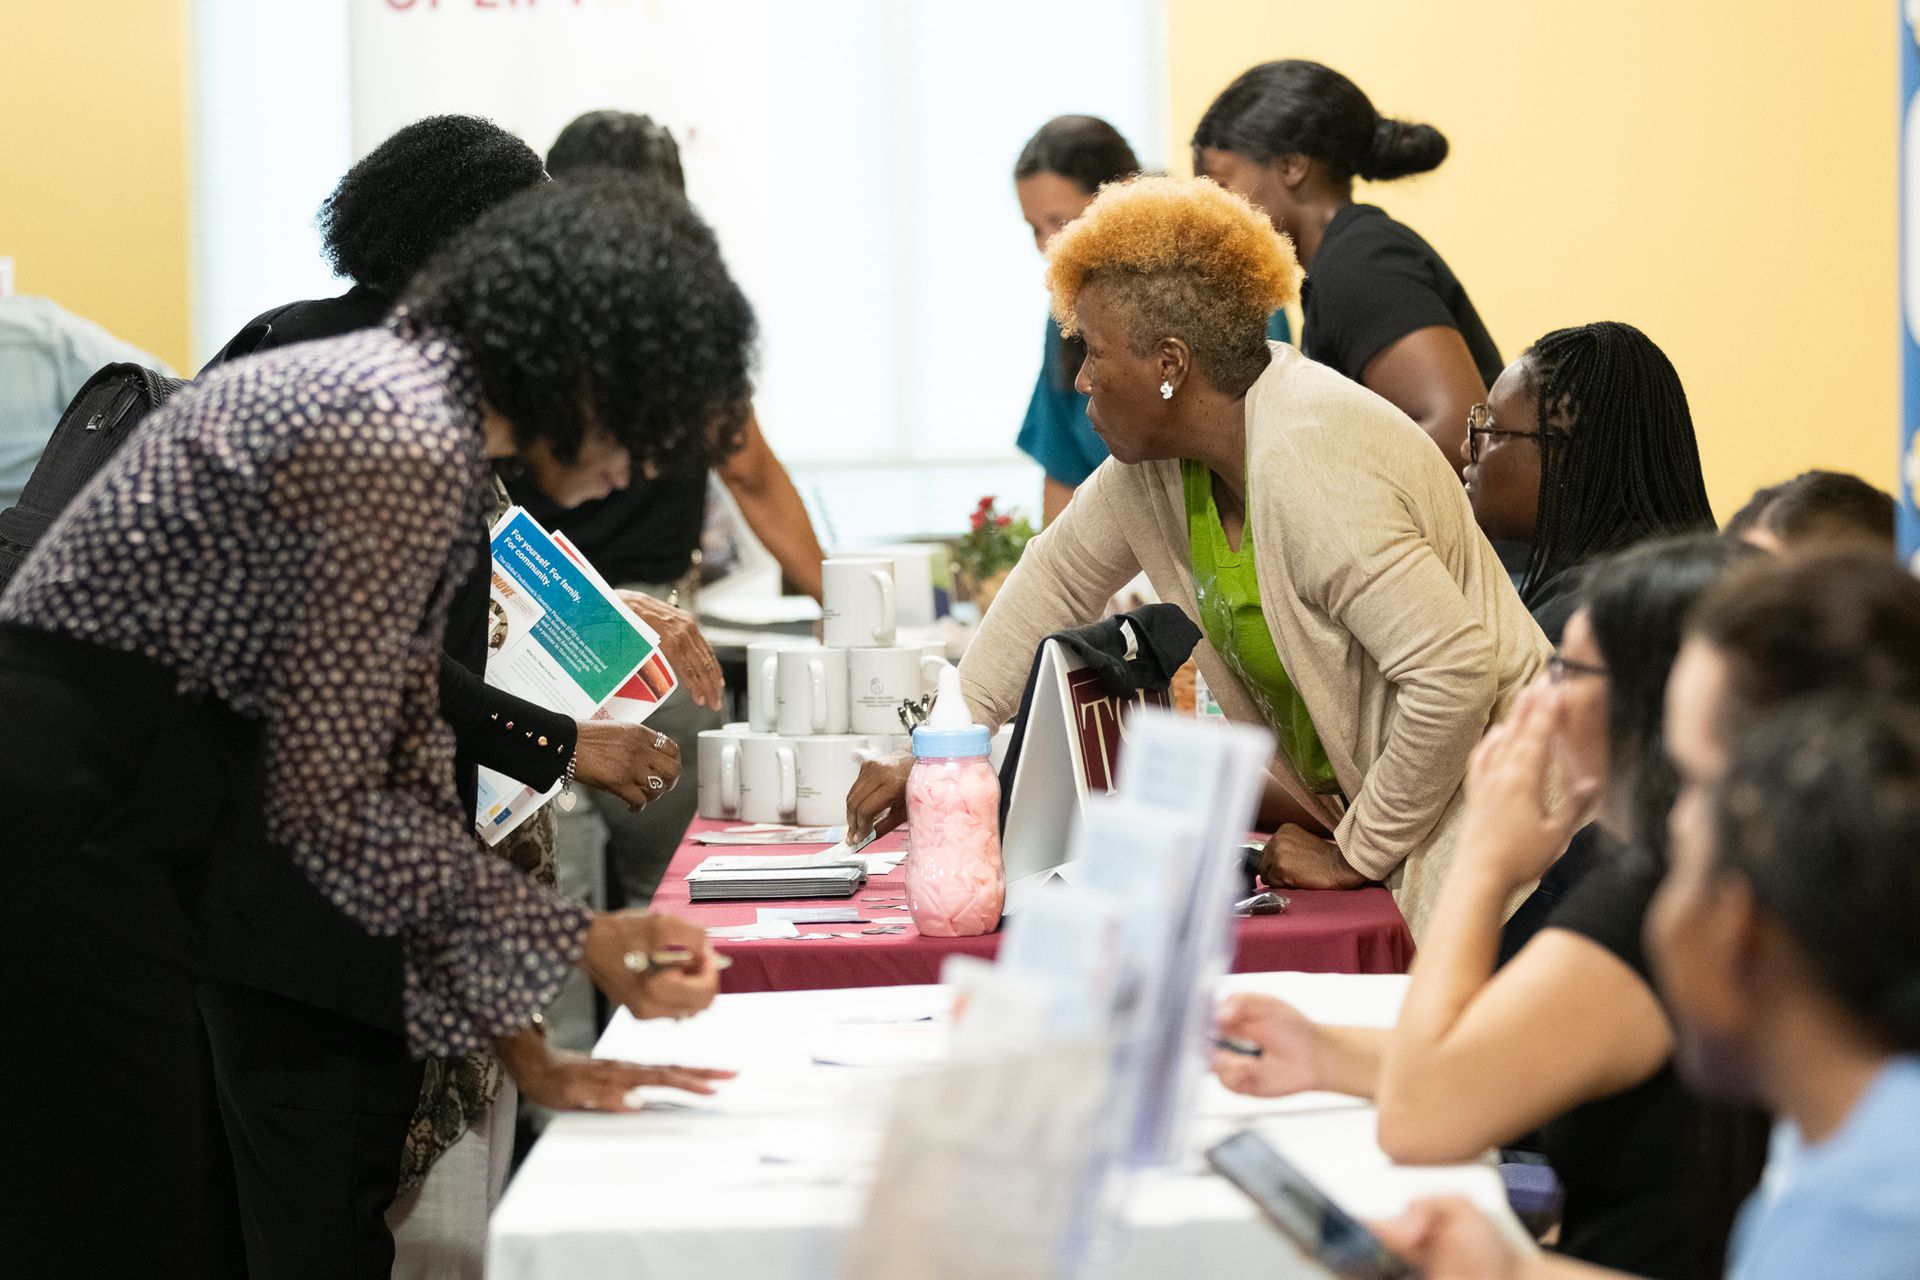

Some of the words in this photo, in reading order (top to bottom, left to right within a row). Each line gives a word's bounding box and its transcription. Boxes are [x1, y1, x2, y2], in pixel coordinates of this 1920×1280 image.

[504, 536, 517, 550] For
[515, 549, 550, 587] community.
[511, 529, 524, 542] For
[521, 541, 550, 570] yourself.
[549, 567, 562, 581] For
[560, 579, 581, 603] family.
